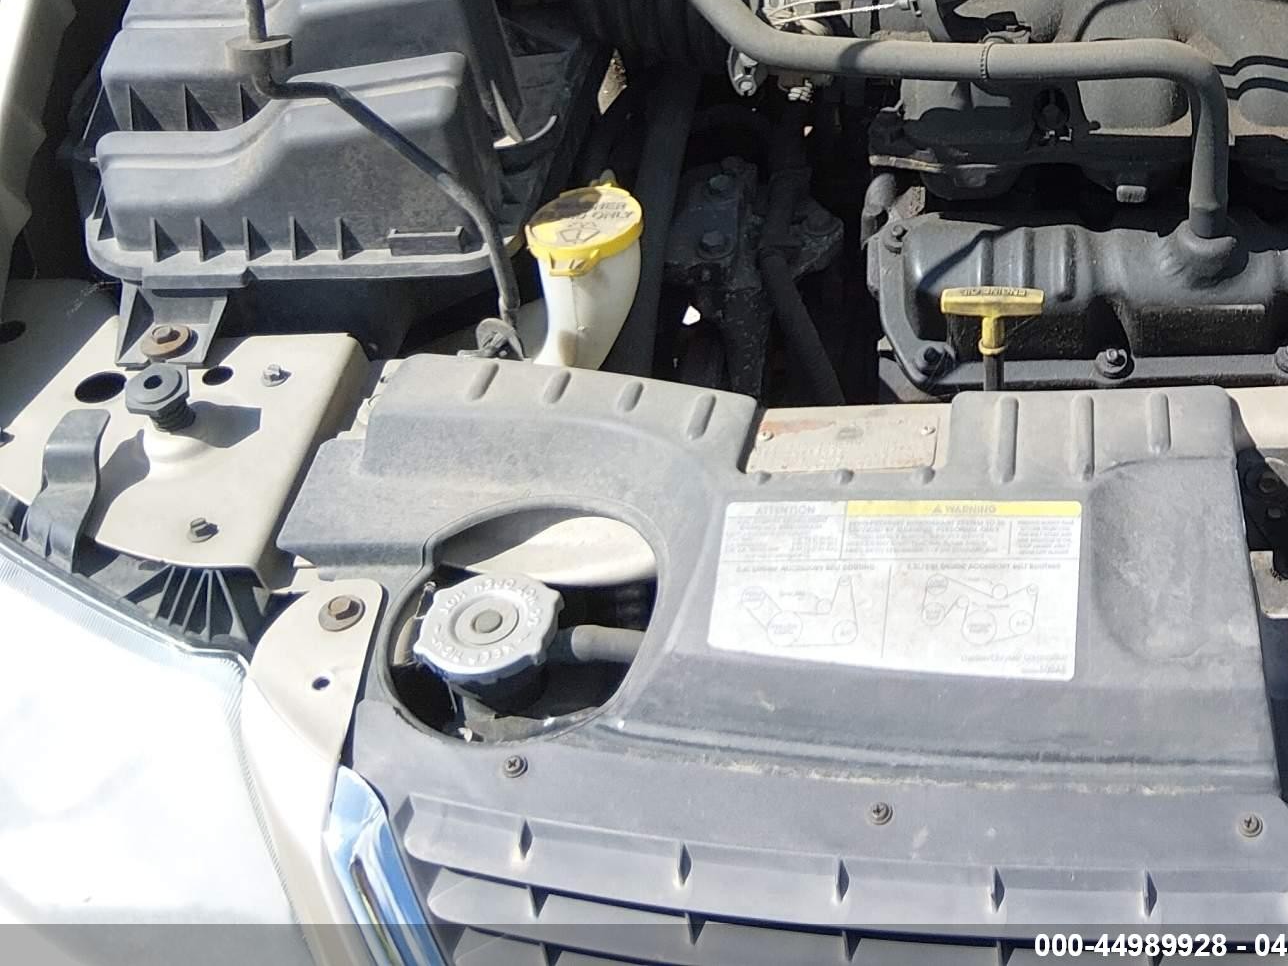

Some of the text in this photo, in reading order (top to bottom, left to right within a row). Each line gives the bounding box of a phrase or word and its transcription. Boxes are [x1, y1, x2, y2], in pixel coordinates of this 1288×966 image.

[592, 211, 634, 220] ONLY
[755, 504, 816, 516] ATTENTION
[945, 504, 997, 515] WARNING
